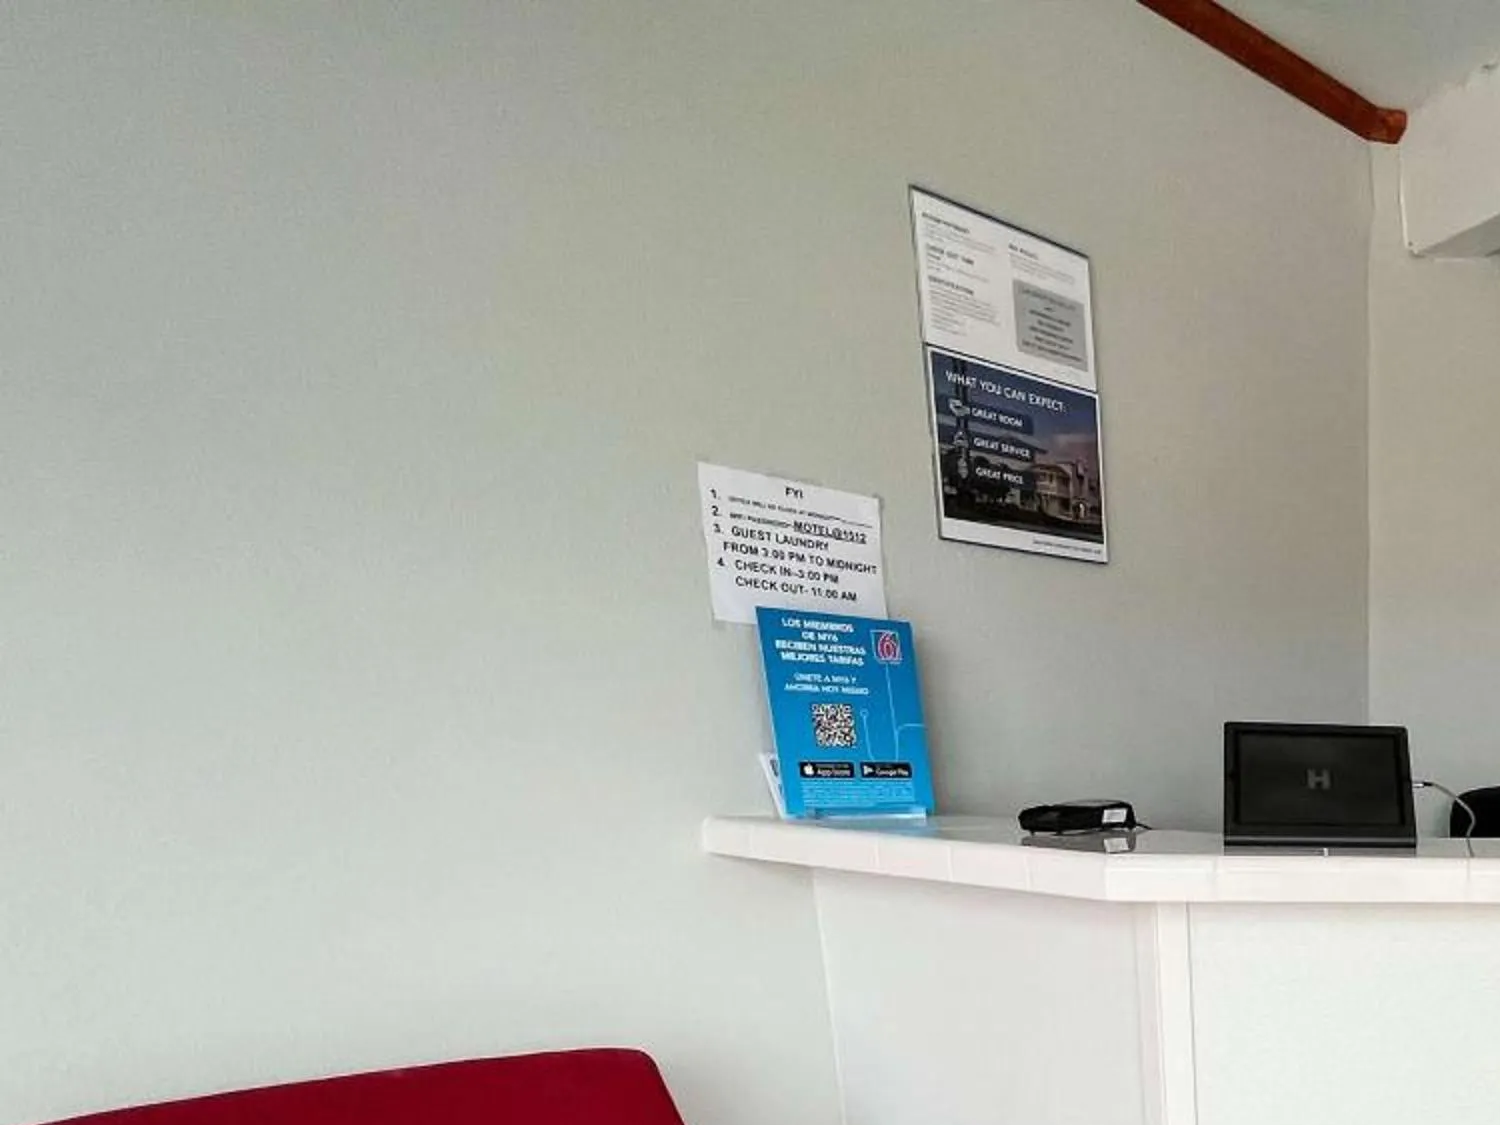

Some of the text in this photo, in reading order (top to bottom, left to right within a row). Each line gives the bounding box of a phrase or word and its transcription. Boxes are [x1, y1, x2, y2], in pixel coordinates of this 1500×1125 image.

[945, 370, 1068, 413] WHAT YOU CAN EXPECT:
[971, 407, 1024, 427] GREAT ROOM
[973, 437, 1032, 458] GREAT SERVICE
[975, 467, 1024, 485] GREAT PRICE
[731, 525, 771, 541] GUEST
[776, 533, 829, 551] LAUNDRY
[723, 541, 758, 556] FROM
[788, 551, 806, 562] PM
[809, 554, 824, 567] TO
[826, 558, 878, 574] MIDNIGHT
[735, 559, 777, 575] CHECK
[823, 573, 839, 584] PM
[735, 576, 778, 591] CHECK
[841, 591, 857, 601] AM
[781, 617, 854, 633] LOS MIEMBROS
[802, 632, 816, 640] DE
[775, 640, 866, 655] RECIBEN NUESTRAS
[780, 651, 864, 666] MEJORES TARIFAS
[1307, 768, 1331, 789] H
